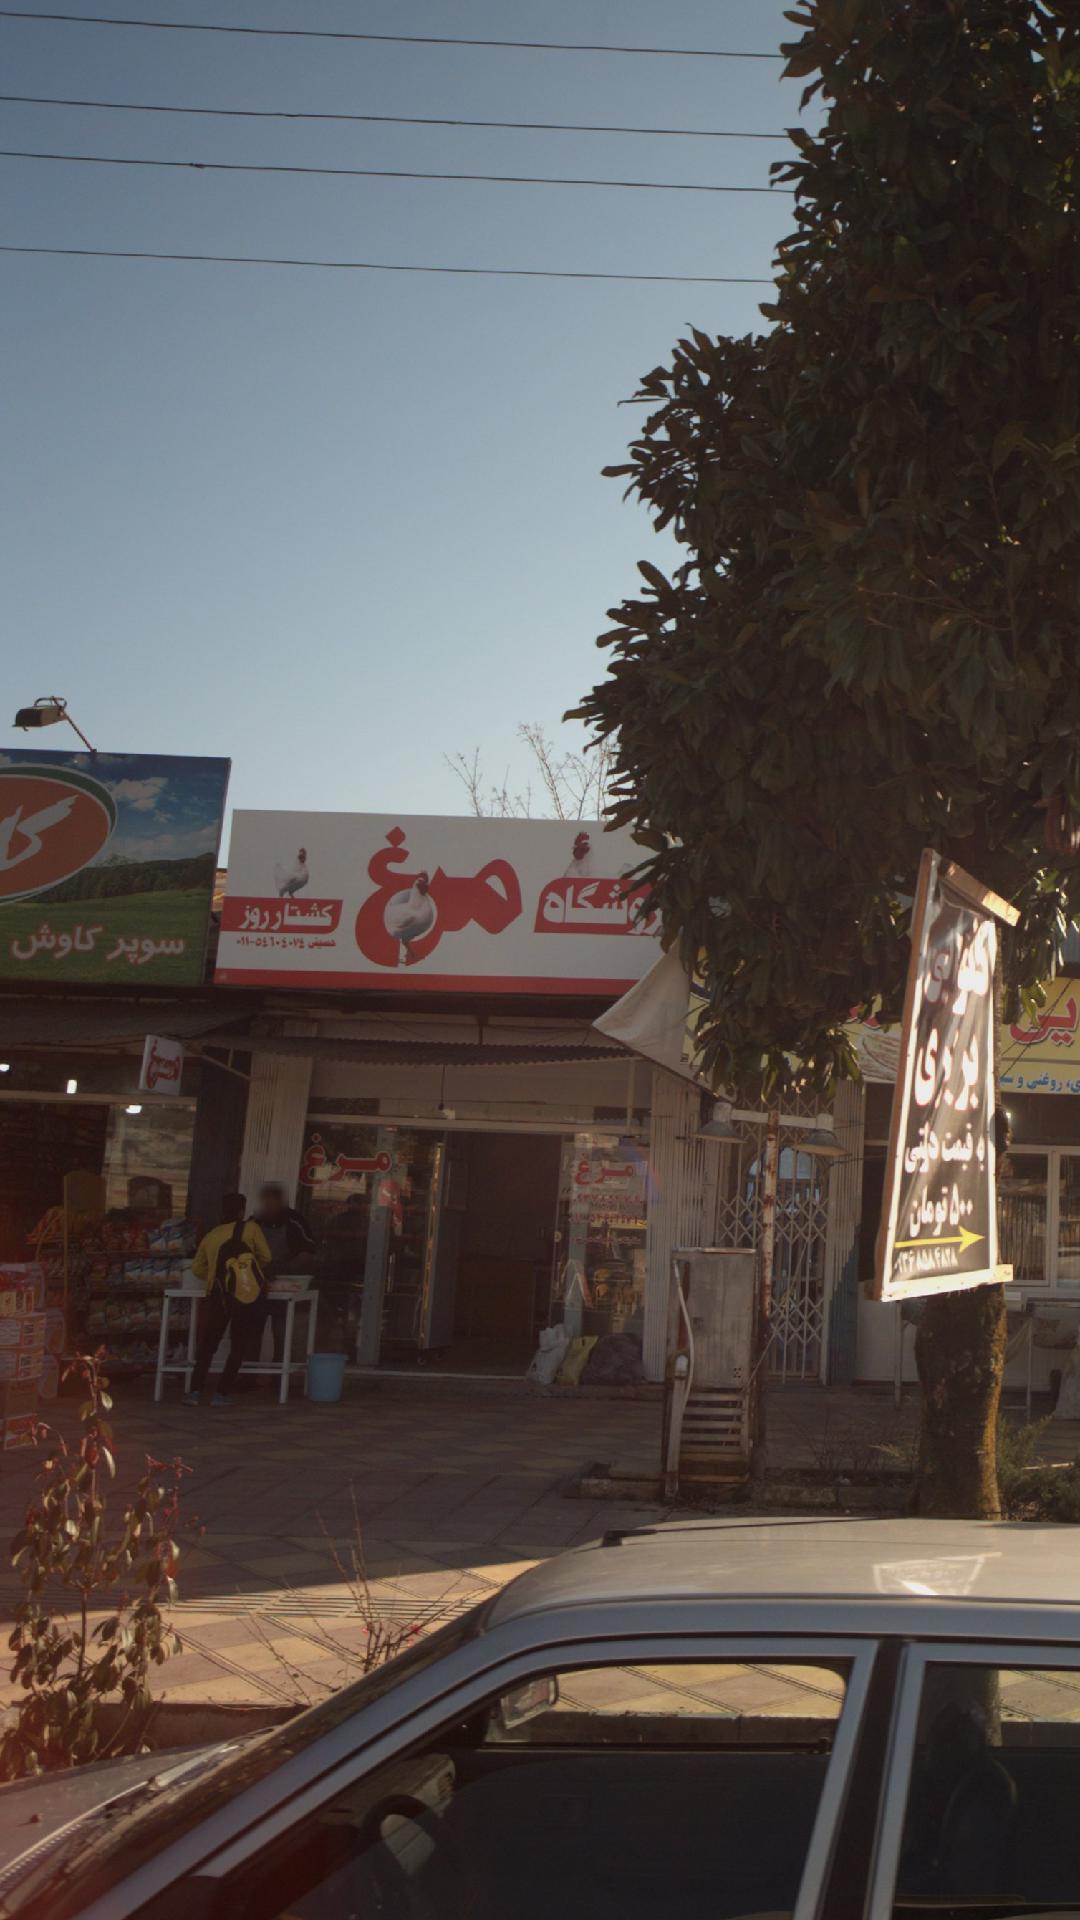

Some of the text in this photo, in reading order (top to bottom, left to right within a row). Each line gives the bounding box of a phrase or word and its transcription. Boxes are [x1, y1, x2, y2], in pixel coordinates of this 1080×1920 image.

[238, 902, 334, 931] کشتار روز
[355, 826, 663, 968] روشگاه مرغ
[10, 920, 185, 966] سوپر کاوش
[299, 1133, 392, 1187] مرغ
[574, 1153, 634, 1186] مرغ
[942, 1122, 974, 1171] قیمت
[909, 1184, 948, 1238] تومان
